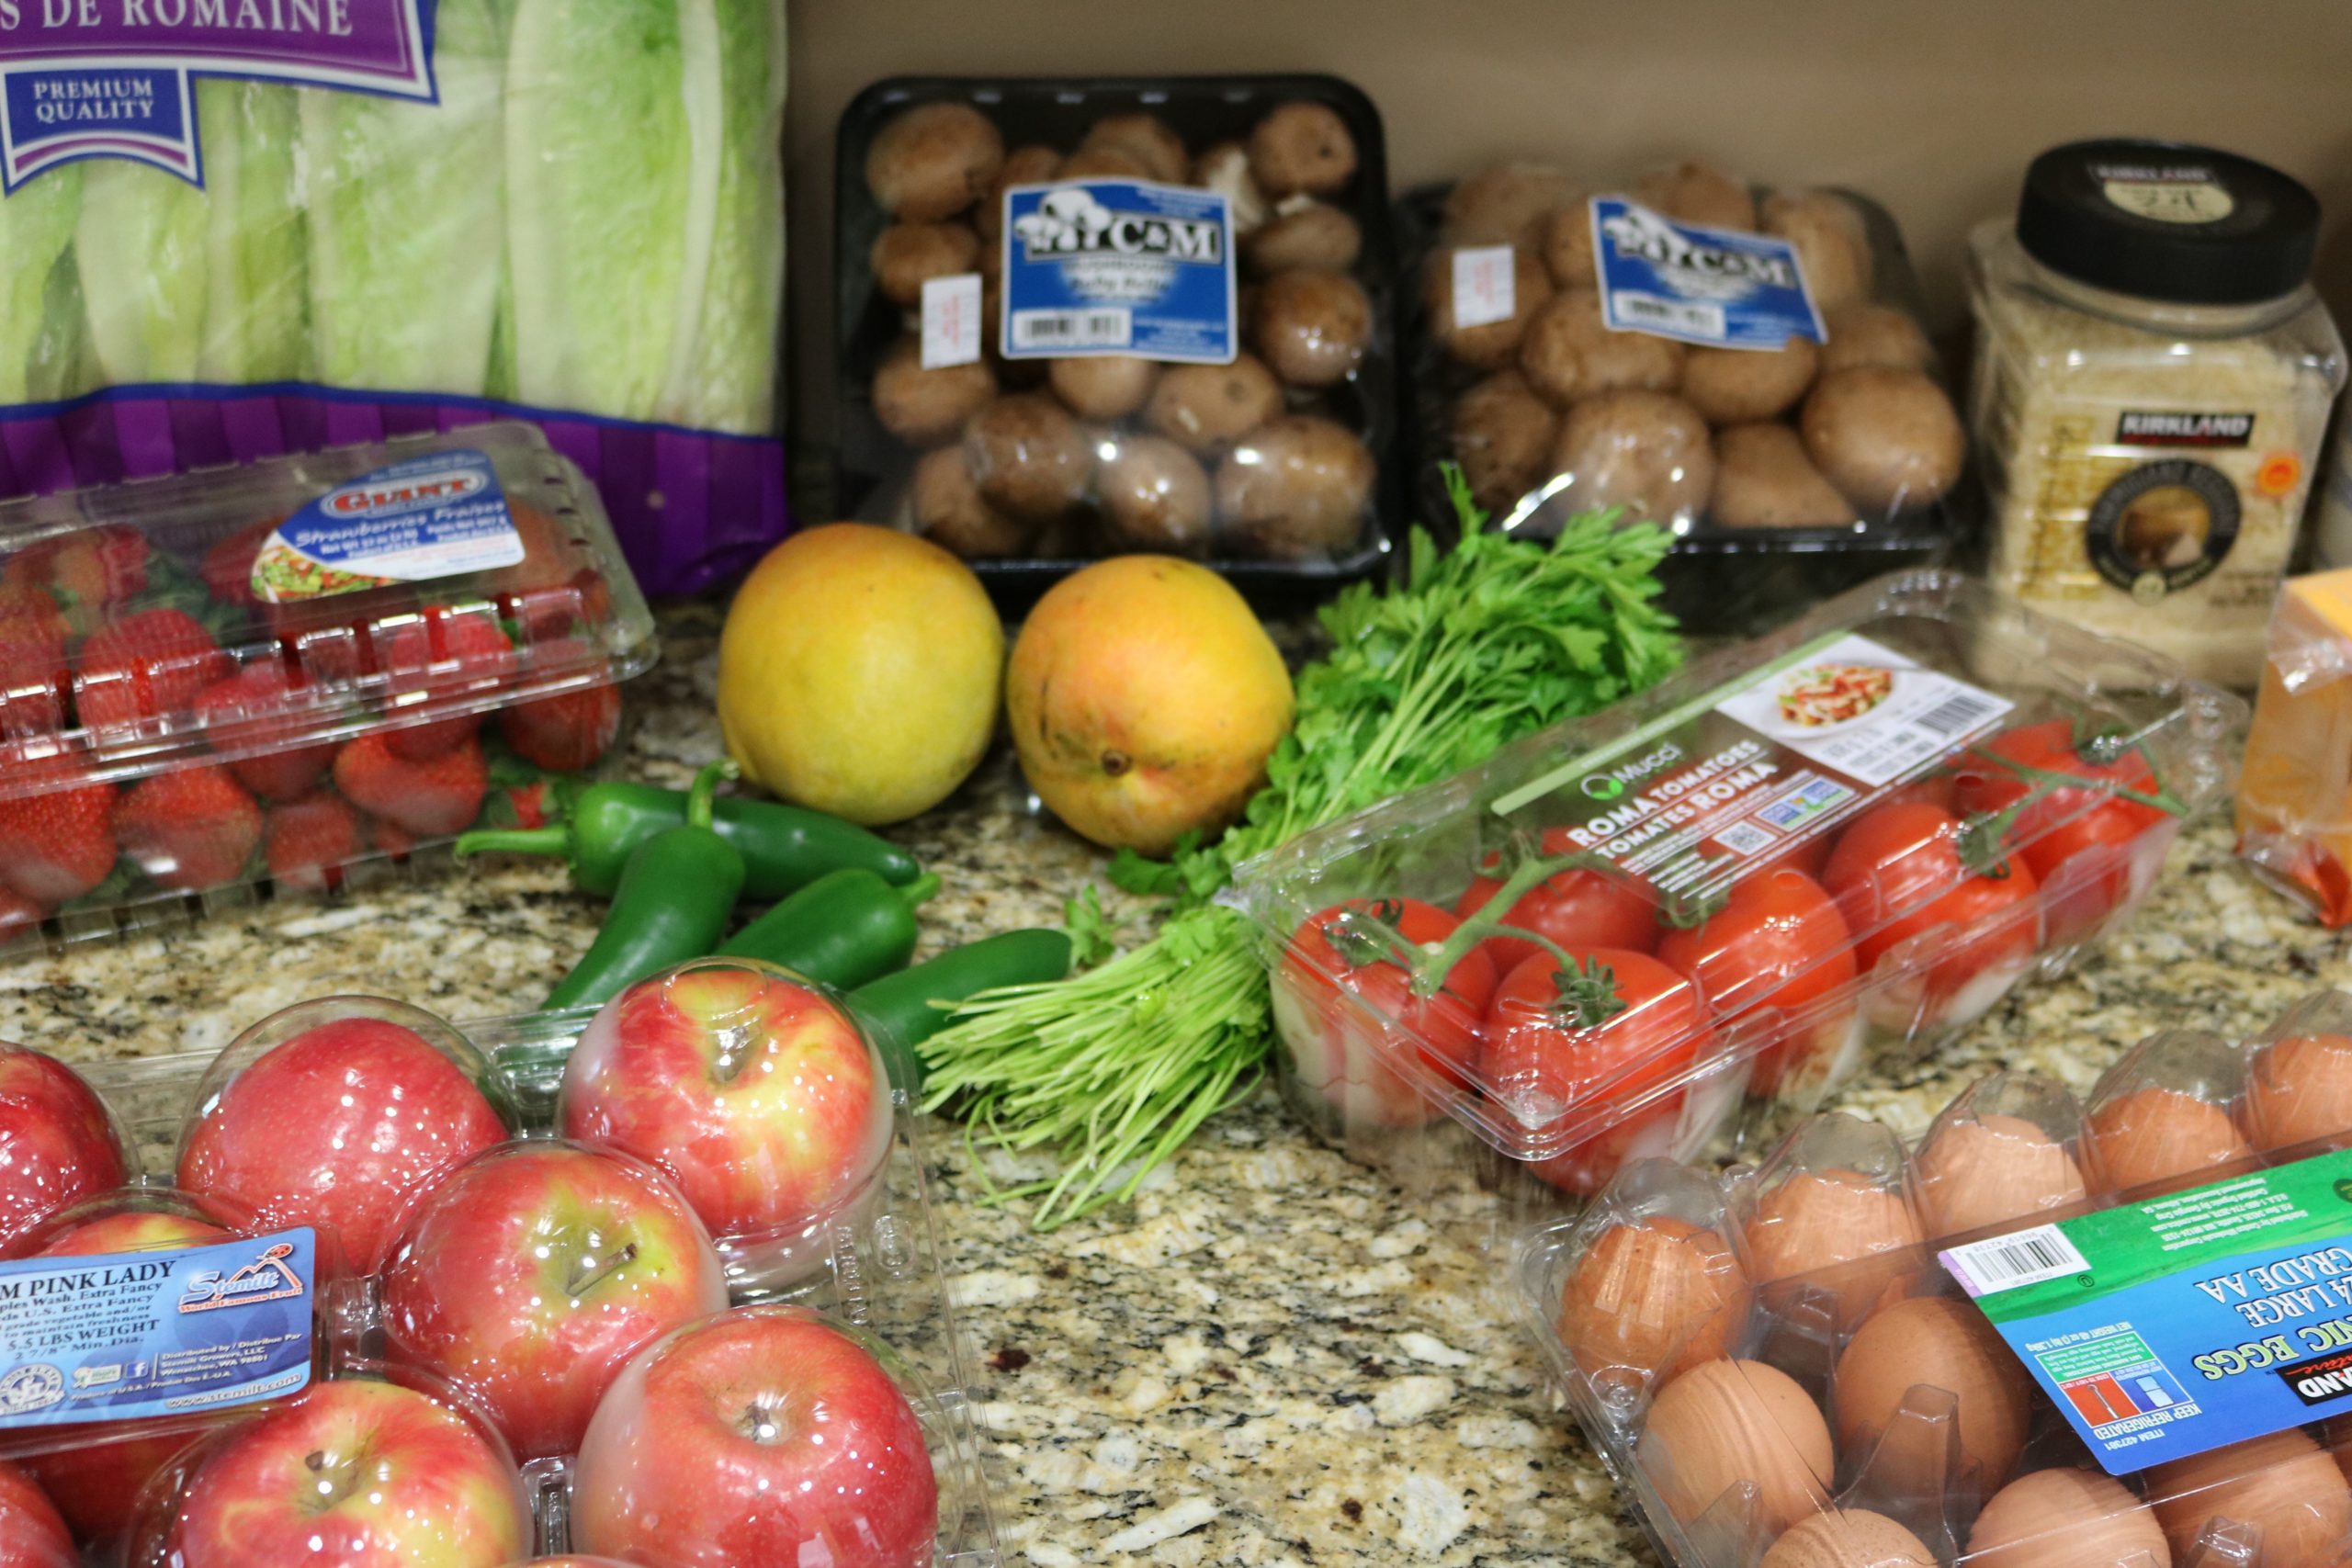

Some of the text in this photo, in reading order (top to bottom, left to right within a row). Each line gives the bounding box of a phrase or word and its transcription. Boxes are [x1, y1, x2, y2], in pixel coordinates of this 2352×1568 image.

[42, 0, 101, 28] DE
[122, 0, 354, 37] ROMAINE
[33, 78, 153, 100] PREMIUM
[35, 99, 154, 123] QUALITY
[2122, 414, 2249, 436] KIRKLAND
[333, 477, 470, 513] GIANT
[295, 513, 427, 548] Strawberries
[1611, 740, 1683, 784] Mucci
[1566, 795, 1661, 848] ROMA
[1648, 739, 1762, 802] TOMATOES
[1593, 803, 1696, 860] TOMATES
[1688, 761, 1781, 812] ROMA
[29, 1272, 98, 1296] PINK
[104, 1260, 176, 1286] LADY
[179, 1271, 280, 1305] Stemilt
[2193, 1247, 2352, 1304] GRADE AA
[33, 1294, 76, 1307] Wash.
[80, 1288, 116, 1301] Extra
[120, 1281, 163, 1295] Fancy
[62, 1301, 102, 1313] Extra
[107, 1294, 154, 1307] Fancy
[2233, 1284, 2337, 1328] LARGE
[7, 1318, 160, 1351] 5.5 LBS WEIGHT
[26, 1322, 85, 1337] maintain
[87, 1314, 150, 1327] freshness
[44, 1311, 103, 1325] vegetable
[162, 1346, 217, 1360] Distributed
[2191, 1334, 2301, 1382] EGGS
[167, 1372, 301, 1410] www.stemilt.com
[2093, 1404, 2202, 1440] KEEP REFRIGERATED
[2140, 1429, 2165, 1443] ITEM
